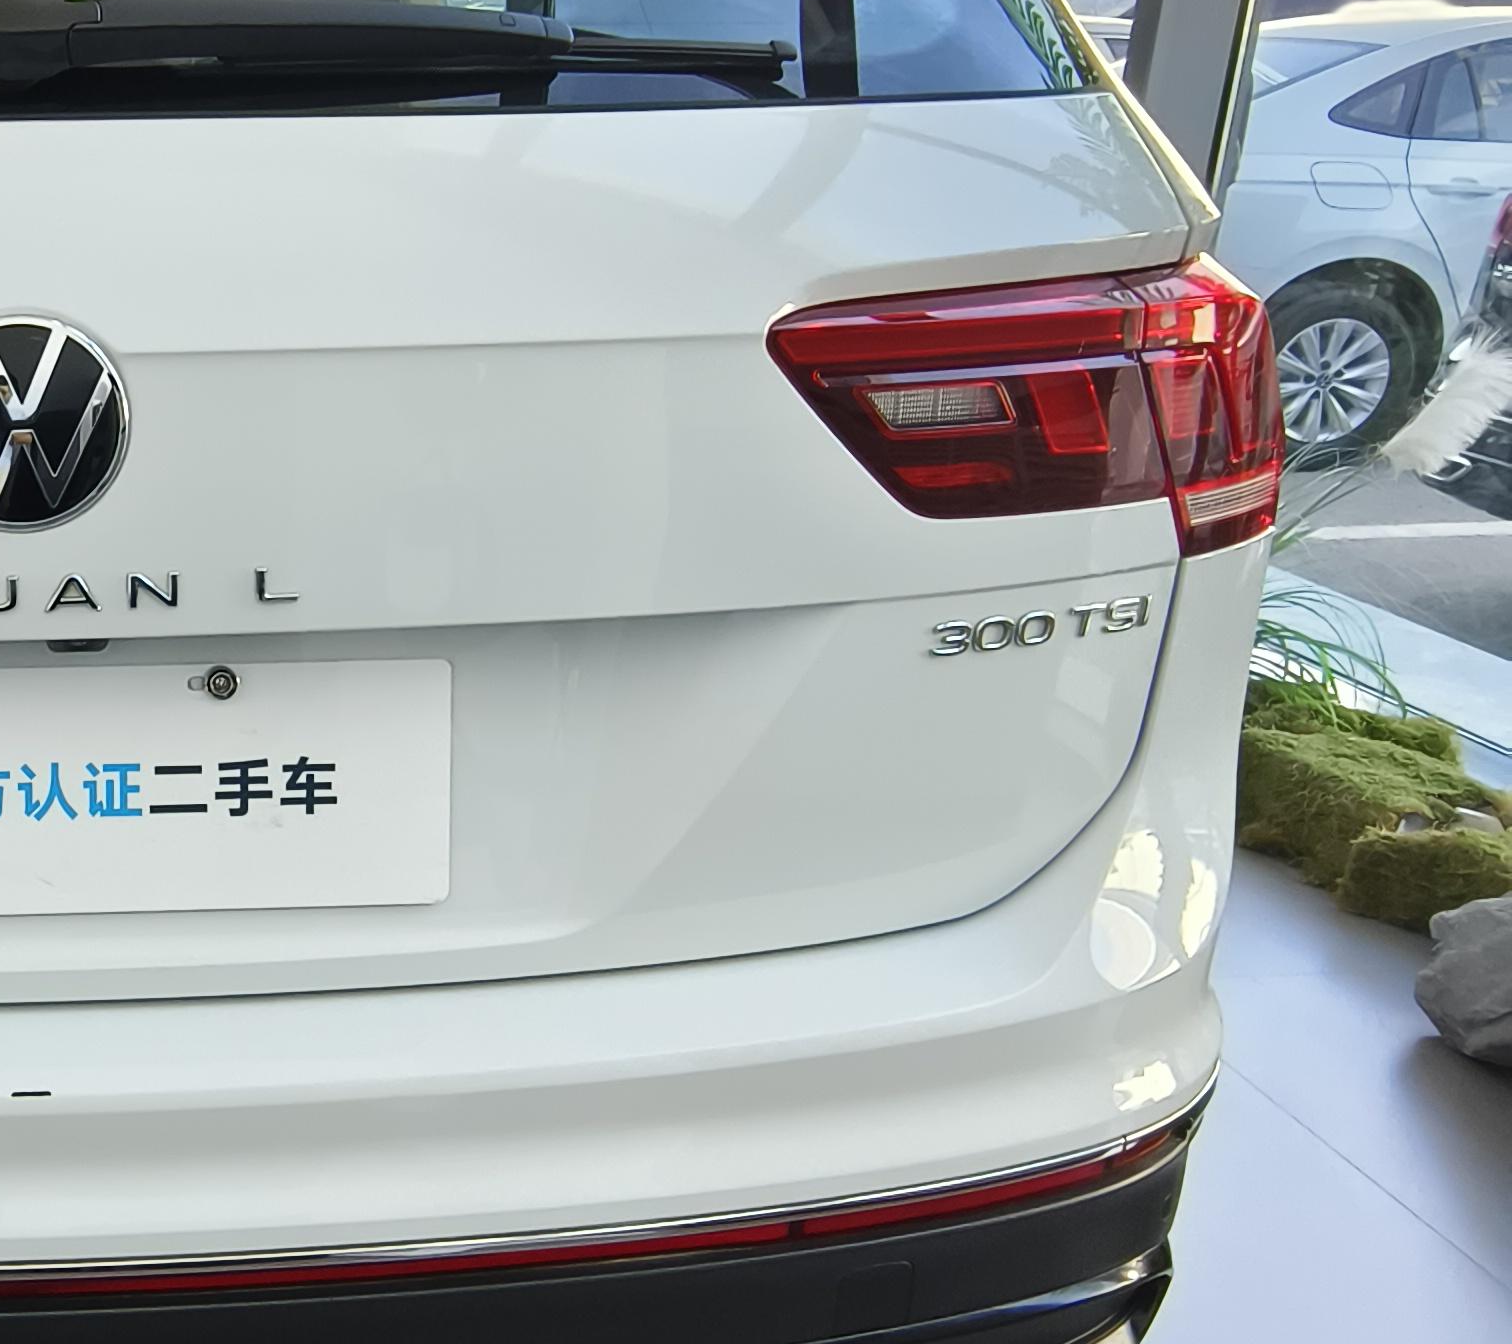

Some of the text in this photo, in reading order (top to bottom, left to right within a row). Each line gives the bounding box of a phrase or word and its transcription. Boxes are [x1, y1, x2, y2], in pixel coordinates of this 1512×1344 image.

[254, 566, 301, 601] L
[929, 593, 1153, 656] 300 TSI
